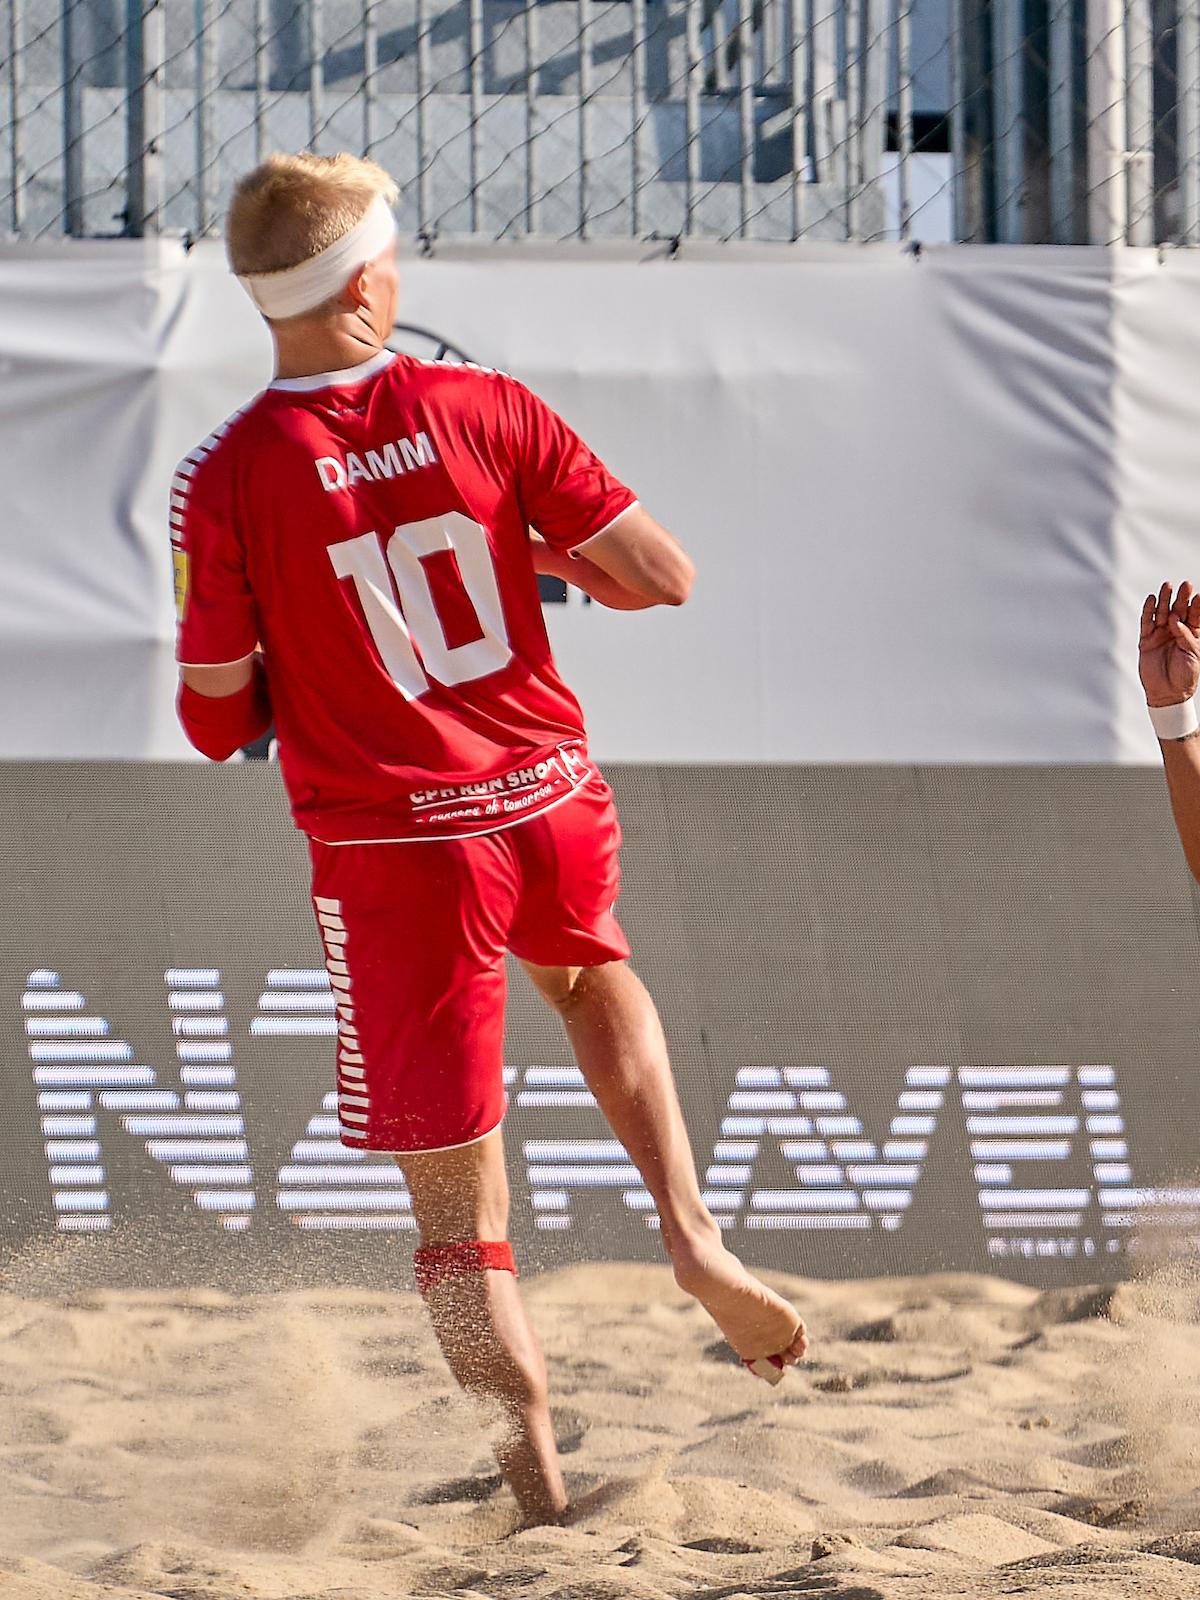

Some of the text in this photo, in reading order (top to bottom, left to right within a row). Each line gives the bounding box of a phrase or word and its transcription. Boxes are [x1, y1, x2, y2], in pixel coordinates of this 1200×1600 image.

[315, 431, 438, 492] DAMM
[326, 511, 513, 702] 10
[460, 778, 504, 796] RUN
[503, 783, 552, 813] tomorrow
